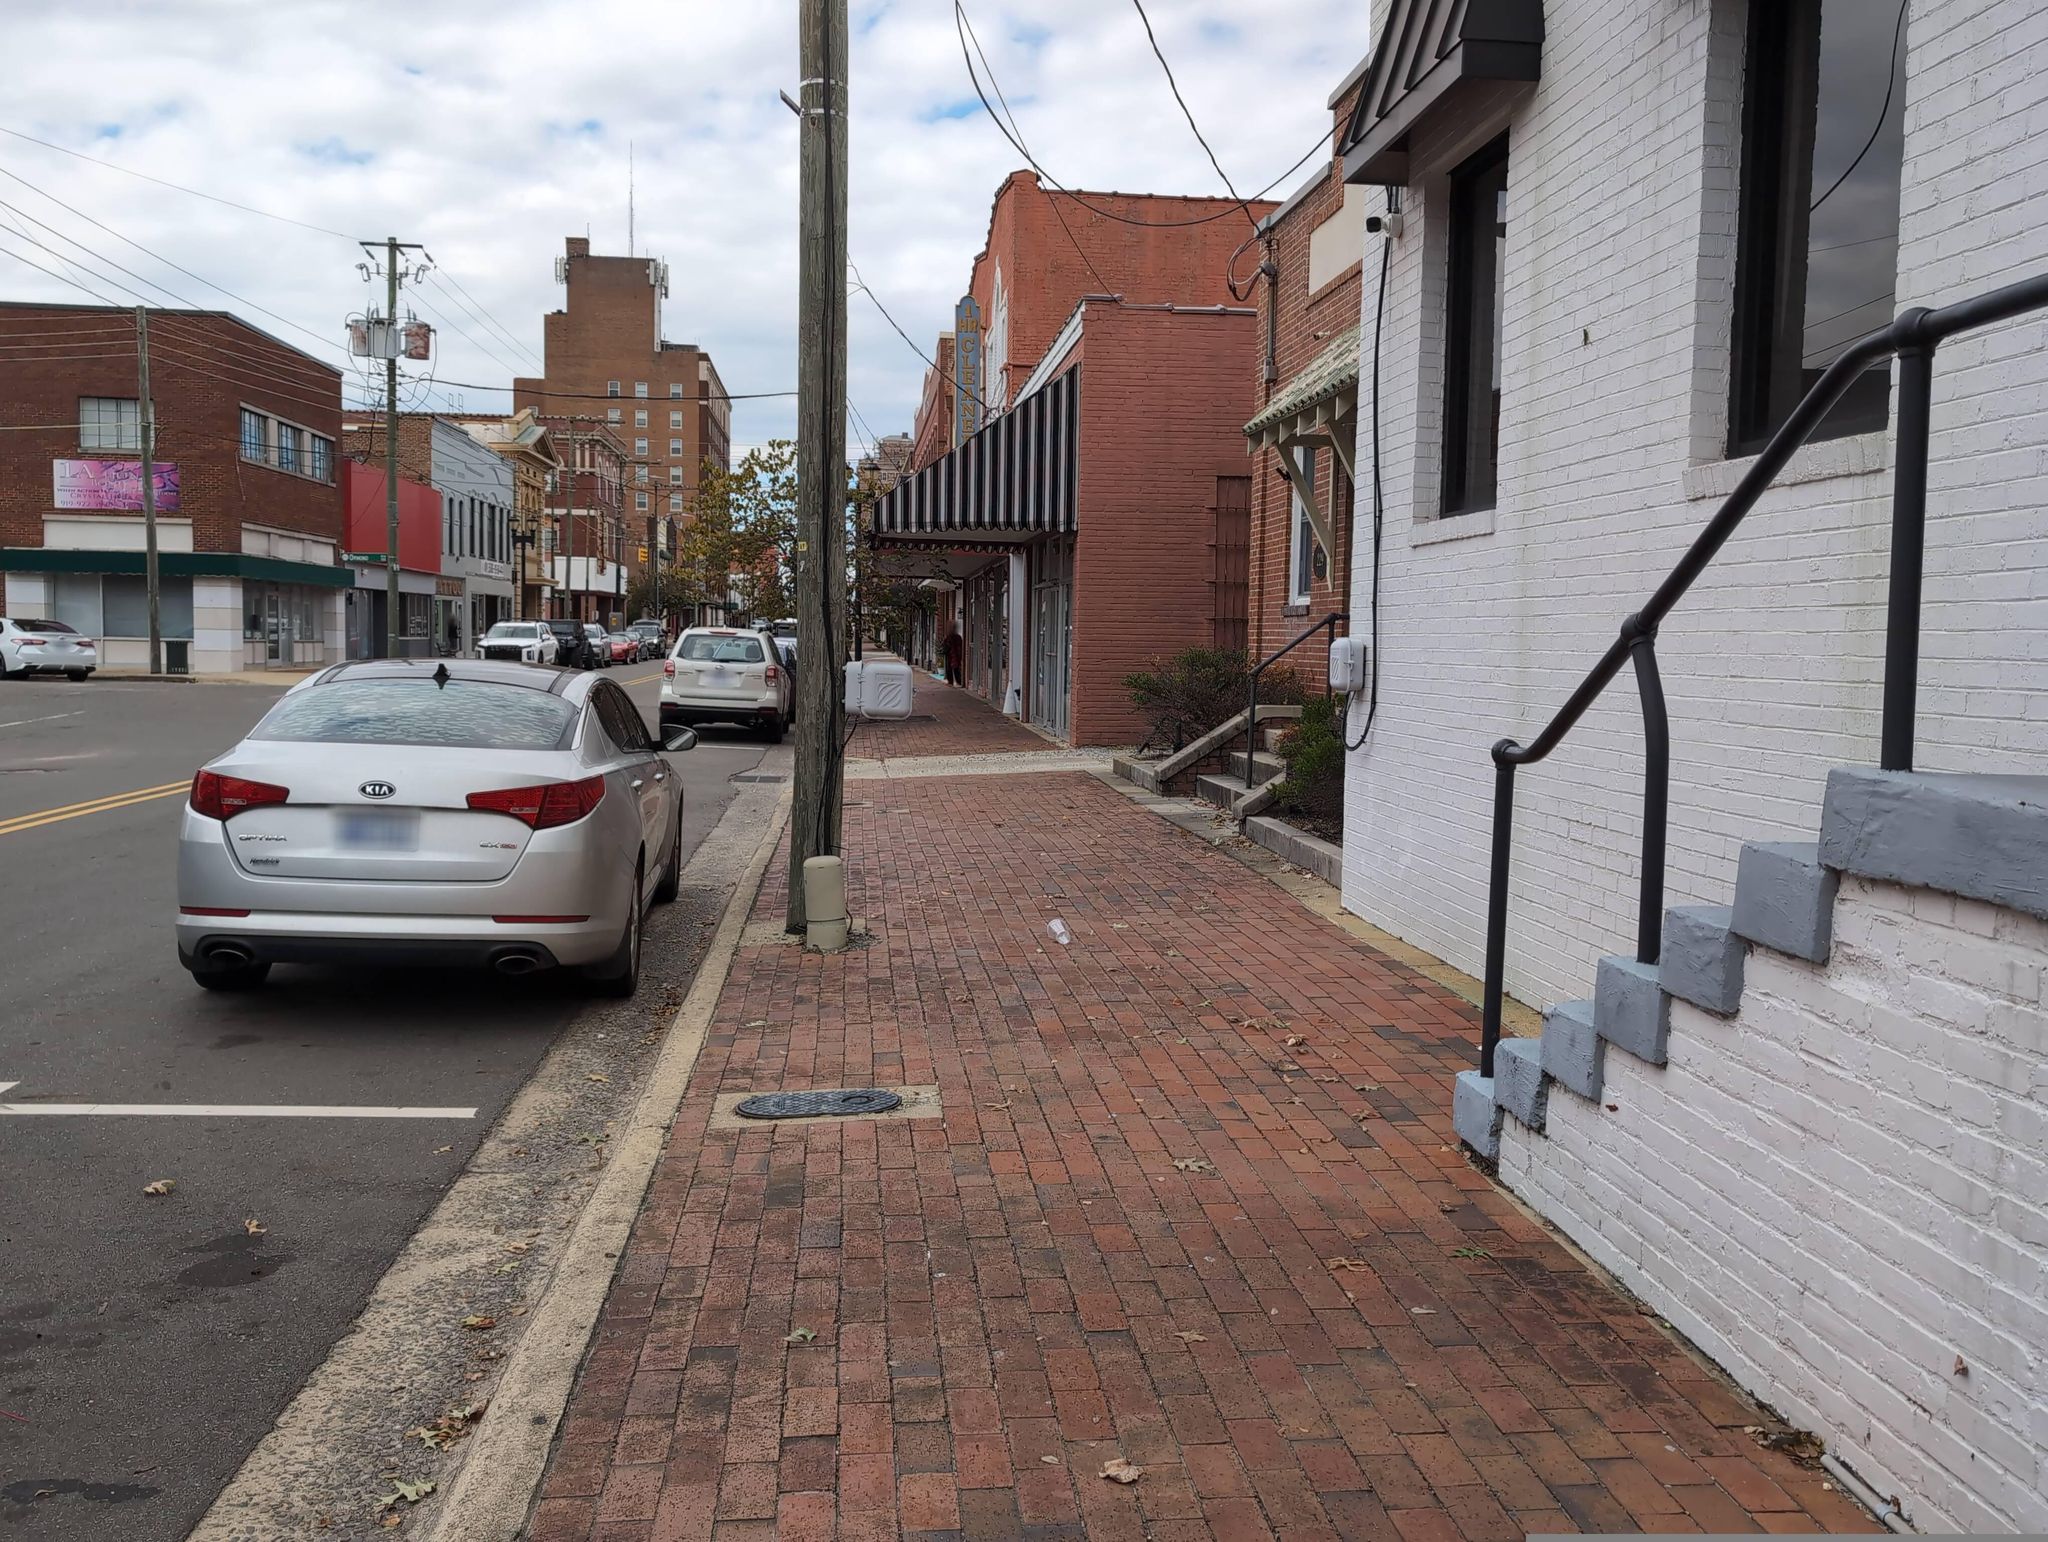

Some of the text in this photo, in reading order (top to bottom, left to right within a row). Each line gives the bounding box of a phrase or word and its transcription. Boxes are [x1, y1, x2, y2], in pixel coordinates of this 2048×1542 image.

[960, 336, 976, 440] CLEANE
[365, 785, 389, 795] KIA
[238, 834, 287, 842] OPTIMA
